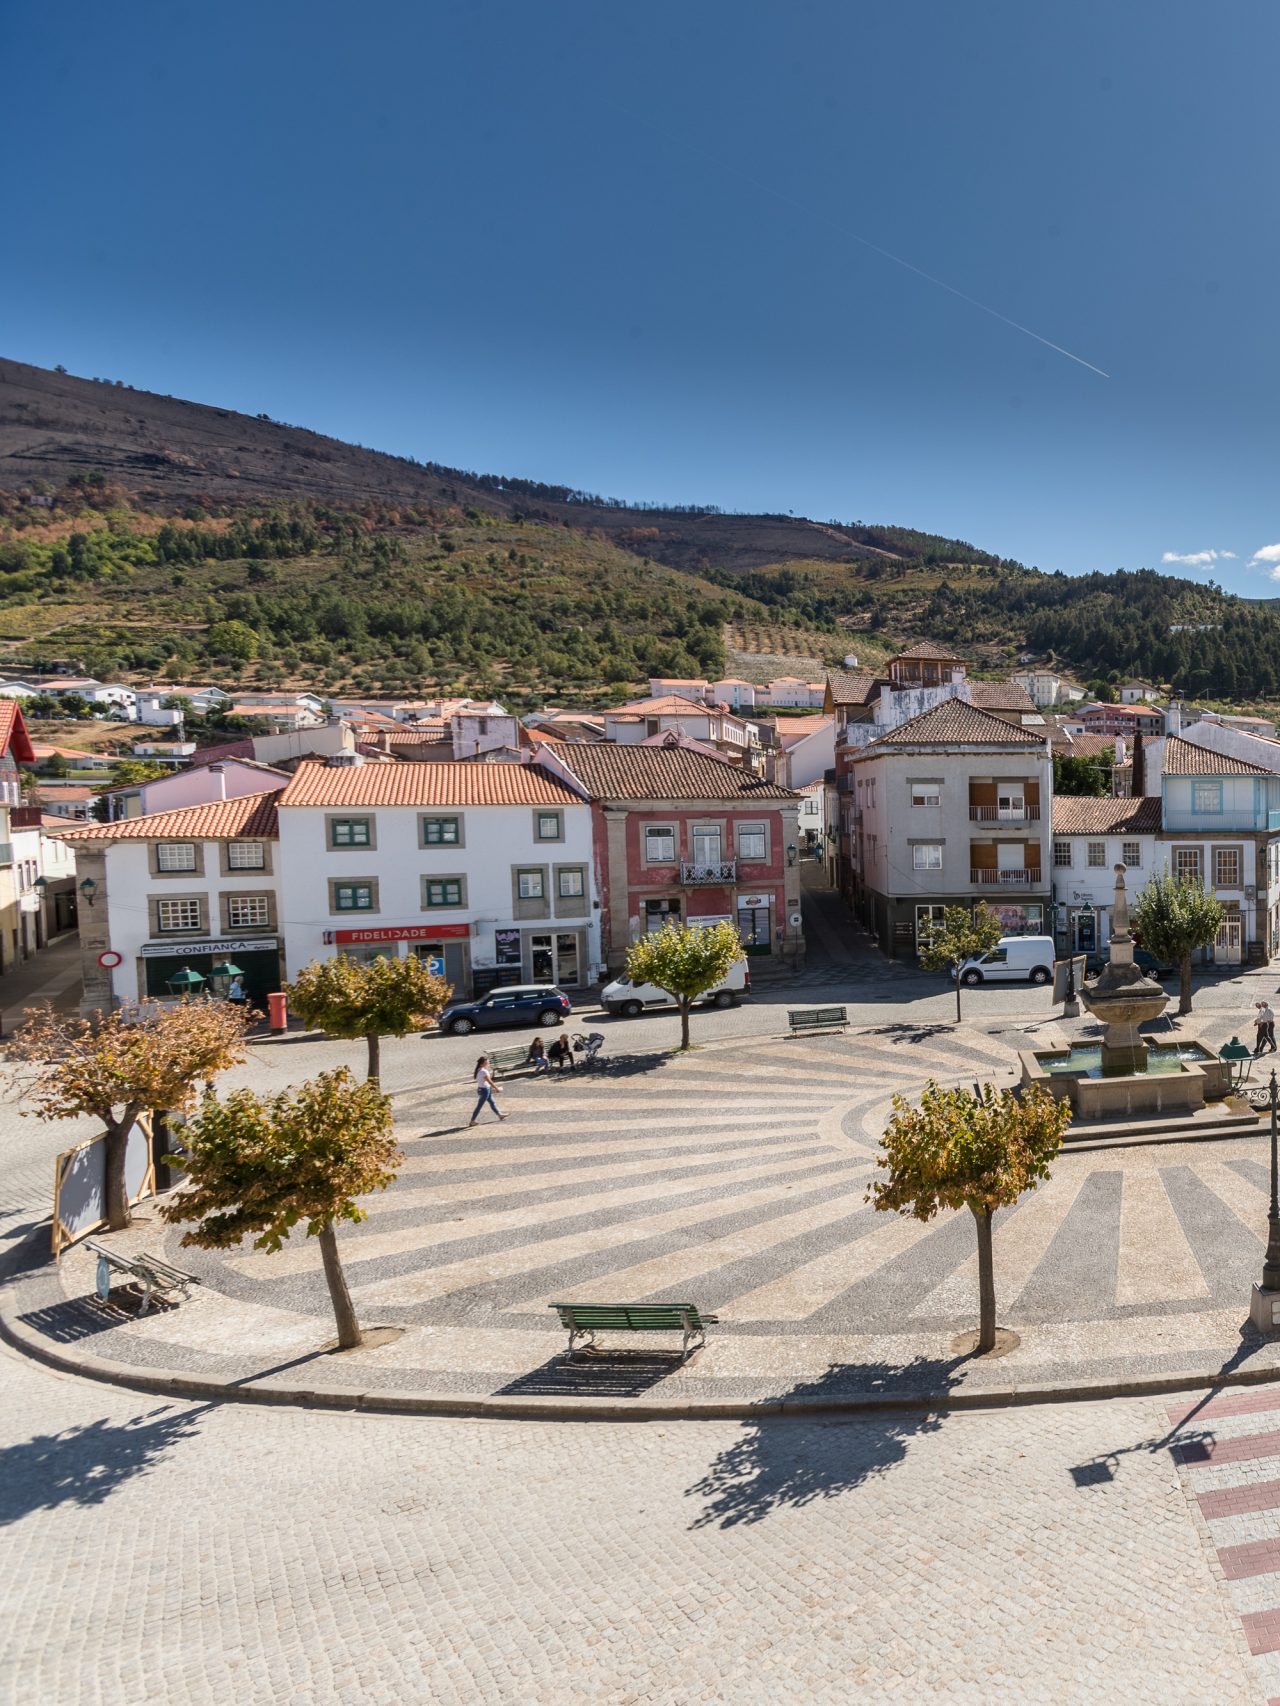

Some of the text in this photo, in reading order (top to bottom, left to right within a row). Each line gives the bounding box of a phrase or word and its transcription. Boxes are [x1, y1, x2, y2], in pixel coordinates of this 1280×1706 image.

[351, 929, 427, 941] FIDELIDADE
[176, 942, 247, 955] CONFIANÇA
[427, 960, 440, 975] P
